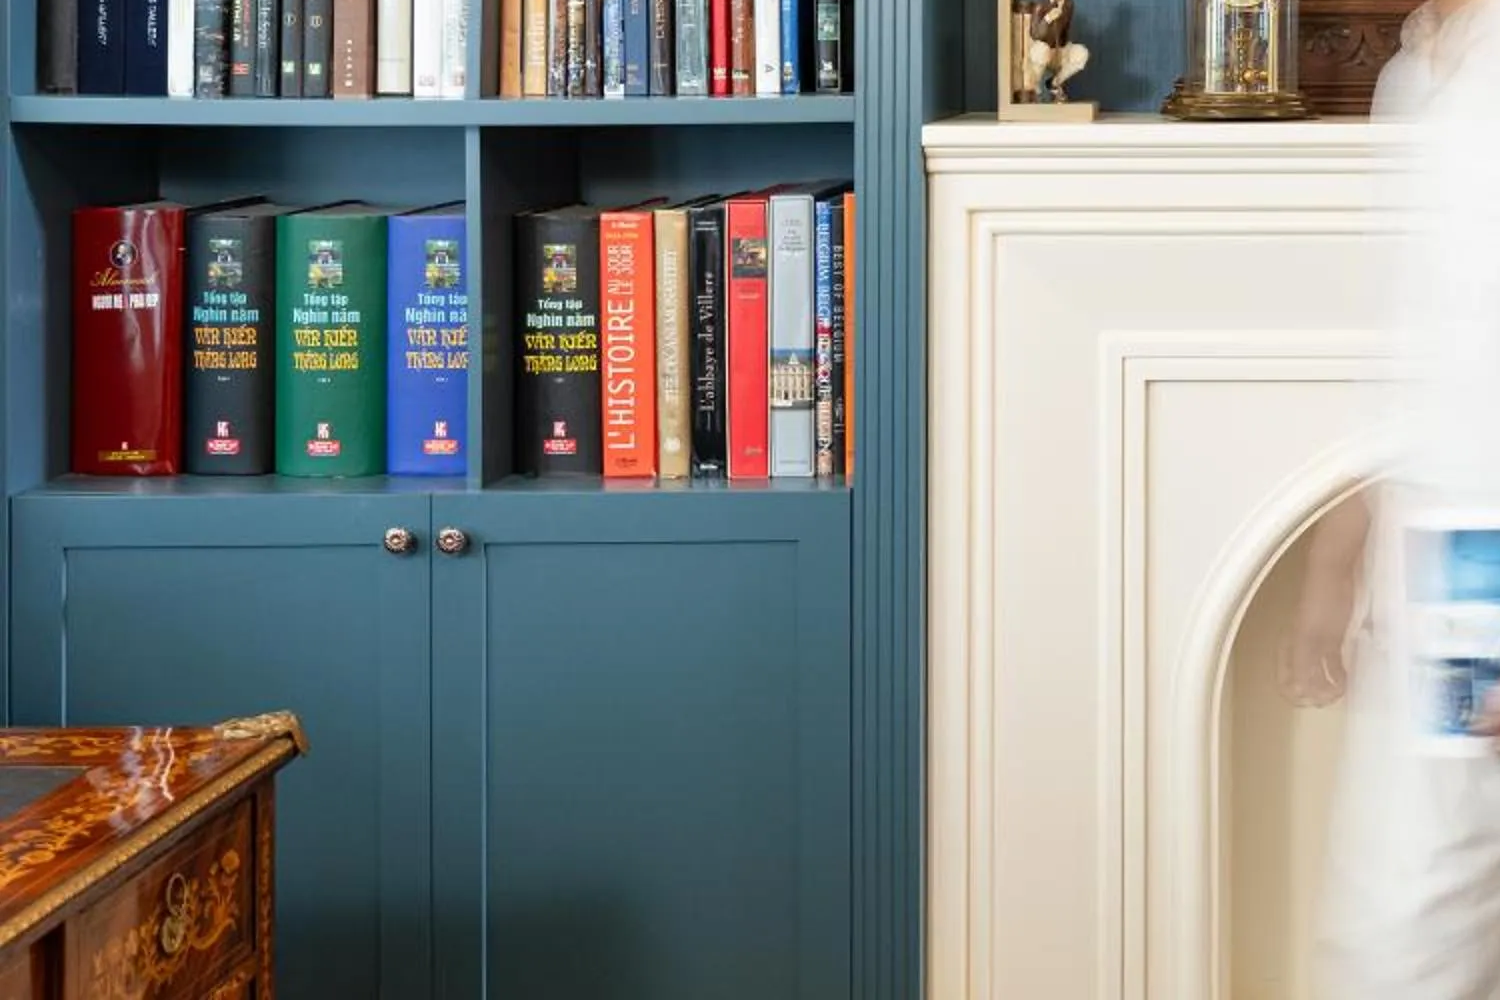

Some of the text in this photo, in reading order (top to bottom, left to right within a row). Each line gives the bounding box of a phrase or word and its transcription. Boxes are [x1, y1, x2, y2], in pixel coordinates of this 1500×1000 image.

[816, 223, 832, 281] BELGIUM
[833, 244, 843, 276] BEST
[697, 324, 713, 341] de
[833, 305, 843, 363] BELGIUM
[608, 301, 636, 450] L'HISTOIRE
